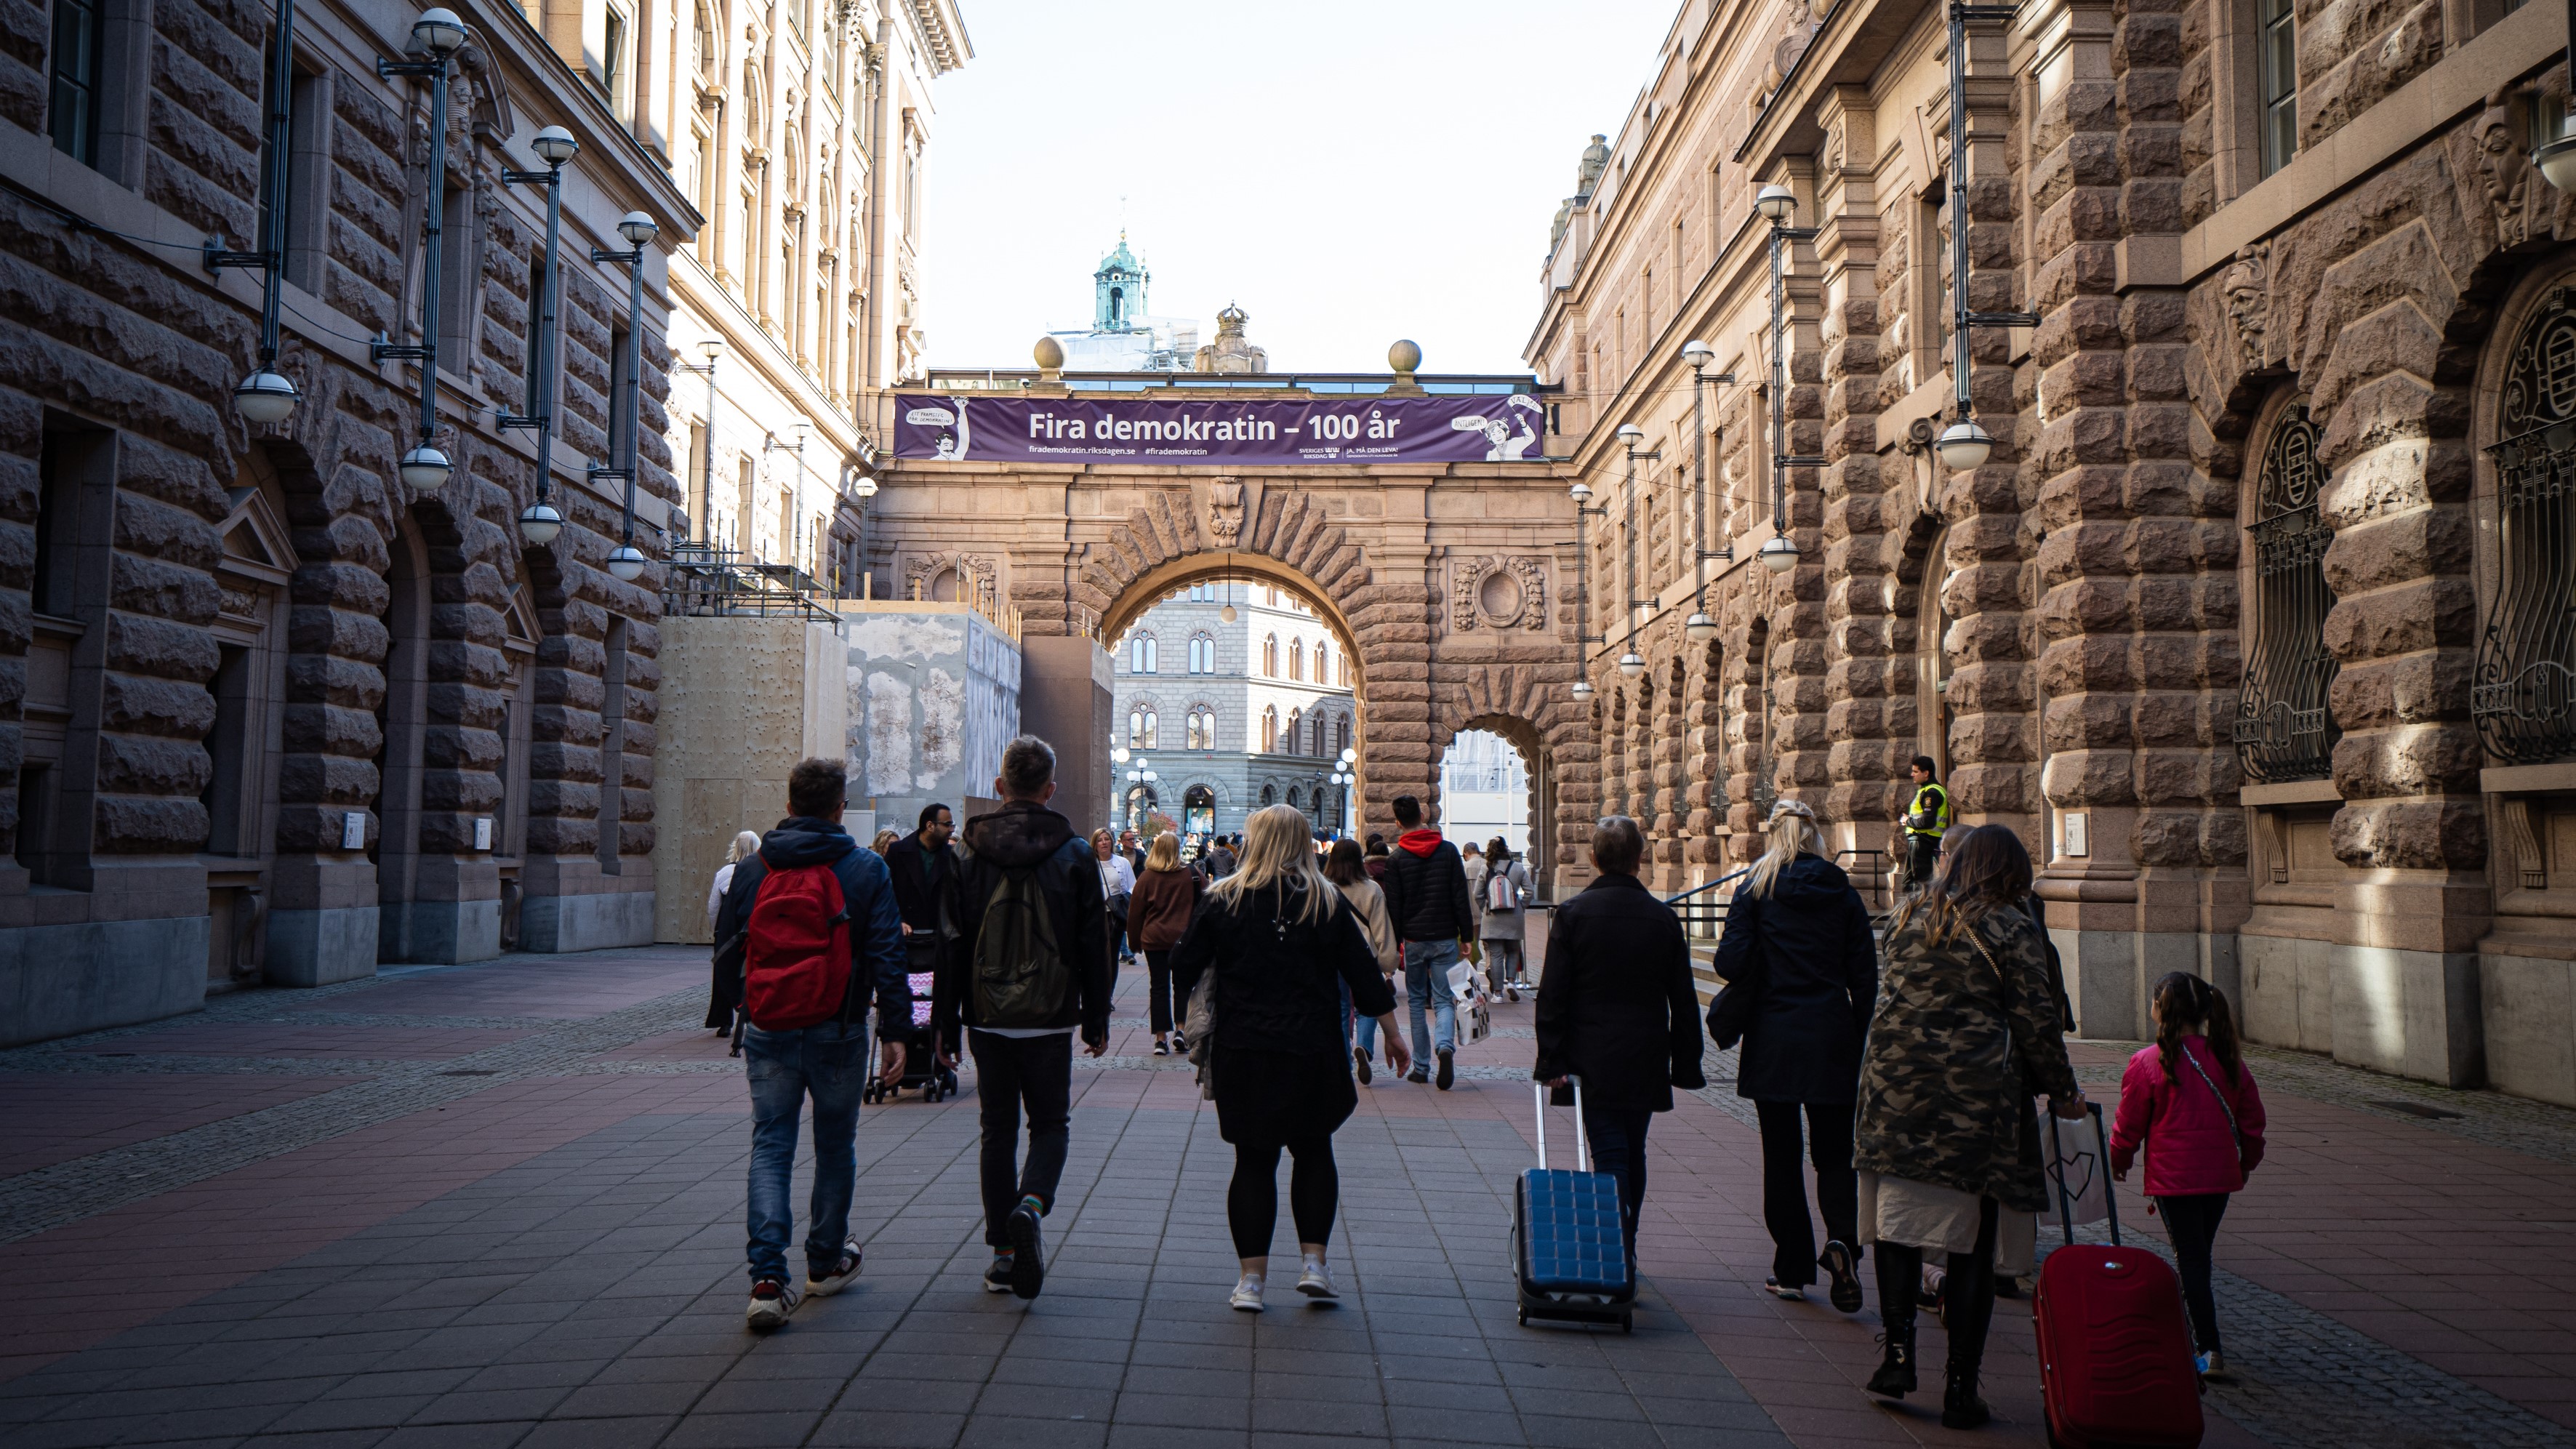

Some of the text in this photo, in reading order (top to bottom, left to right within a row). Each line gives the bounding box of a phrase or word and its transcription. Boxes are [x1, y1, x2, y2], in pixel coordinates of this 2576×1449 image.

[1030, 412, 1086, 439] Fira
[1094, 413, 1276, 441] demokratin
[1308, 414, 1359, 440] 100
[1367, 410, 1400, 439] år
[1029, 446, 1136, 456] firademokratin.riksdagen.se
